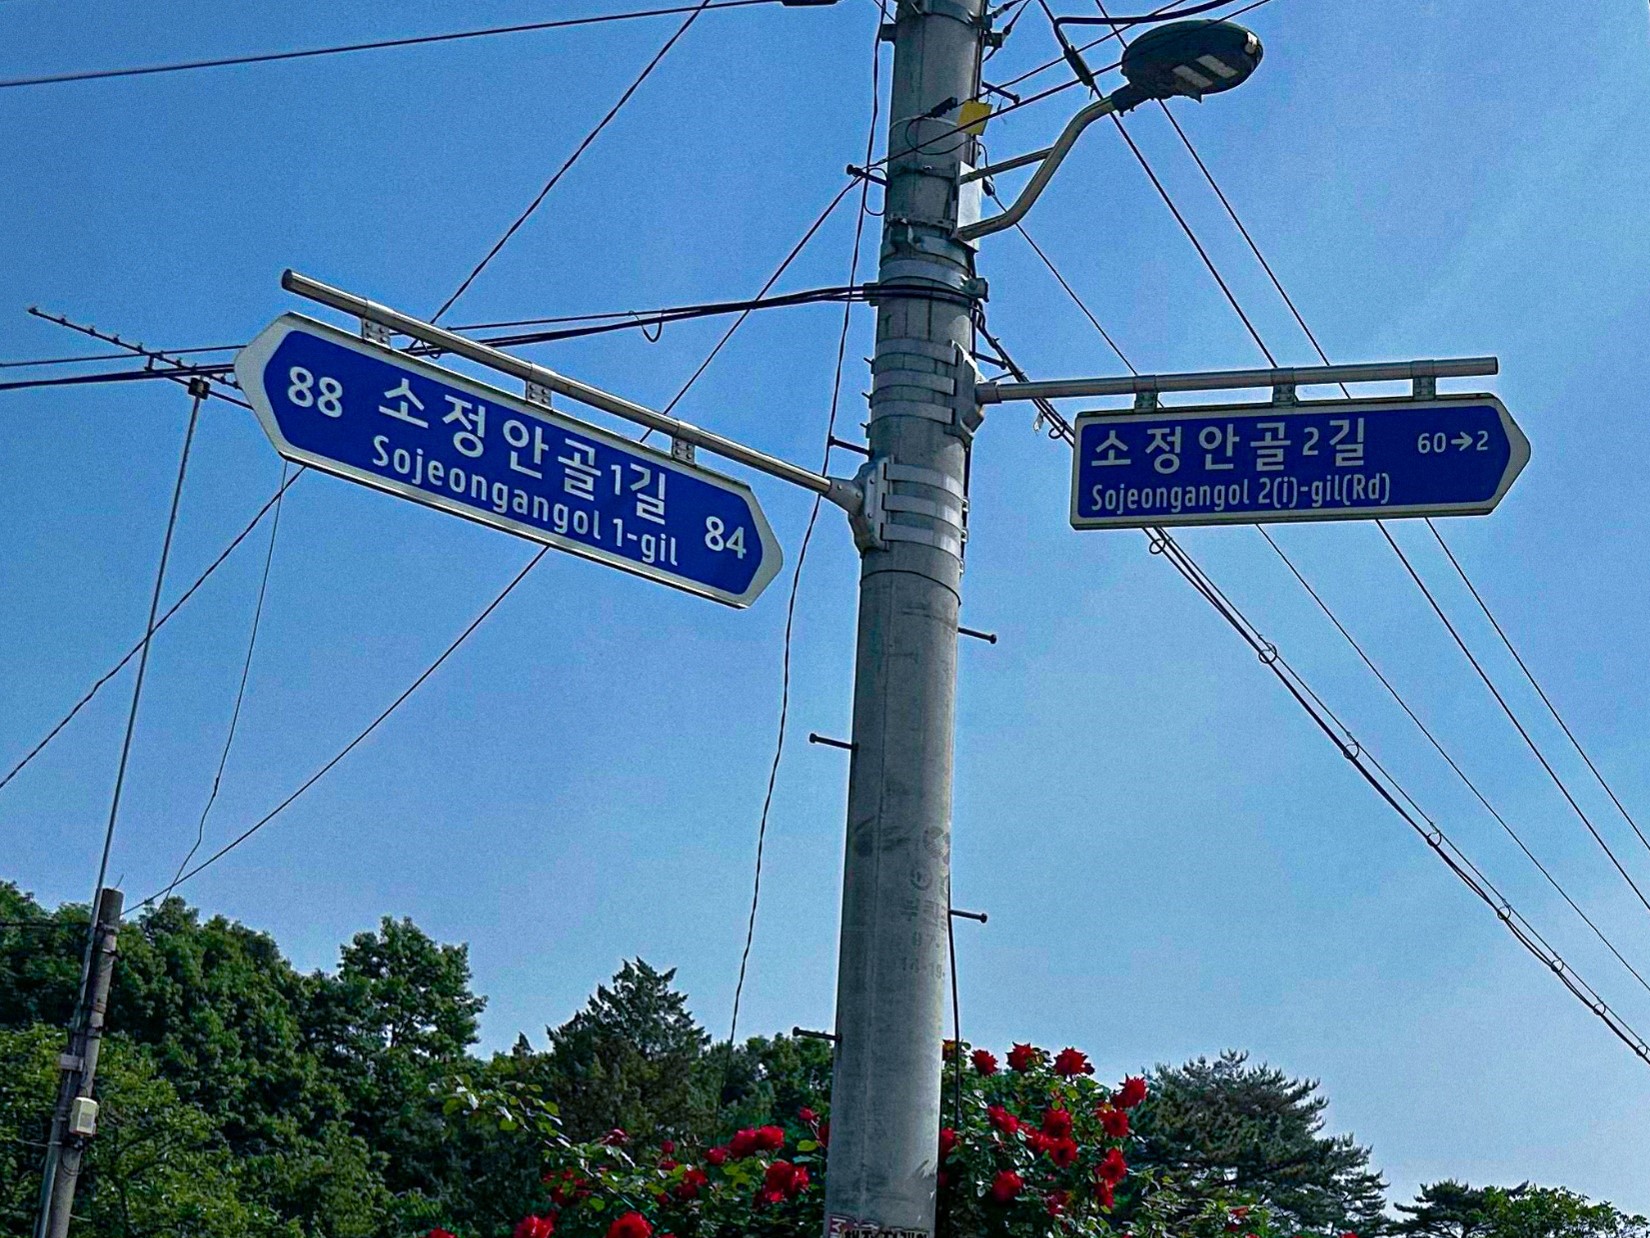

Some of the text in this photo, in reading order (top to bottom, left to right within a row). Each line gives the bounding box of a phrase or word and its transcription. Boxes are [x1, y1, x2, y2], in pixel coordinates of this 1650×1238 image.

[287, 366, 344, 419] 88
[378, 378, 667, 526] 소정안골1길
[1091, 417, 1367, 475] 소정안골2길
[372, 435, 679, 568] Sojeongangol 1-gil
[1091, 472, 1391, 514] Sojeongangol 2(i)-gil(Rd)
[704, 516, 748, 560] 84
